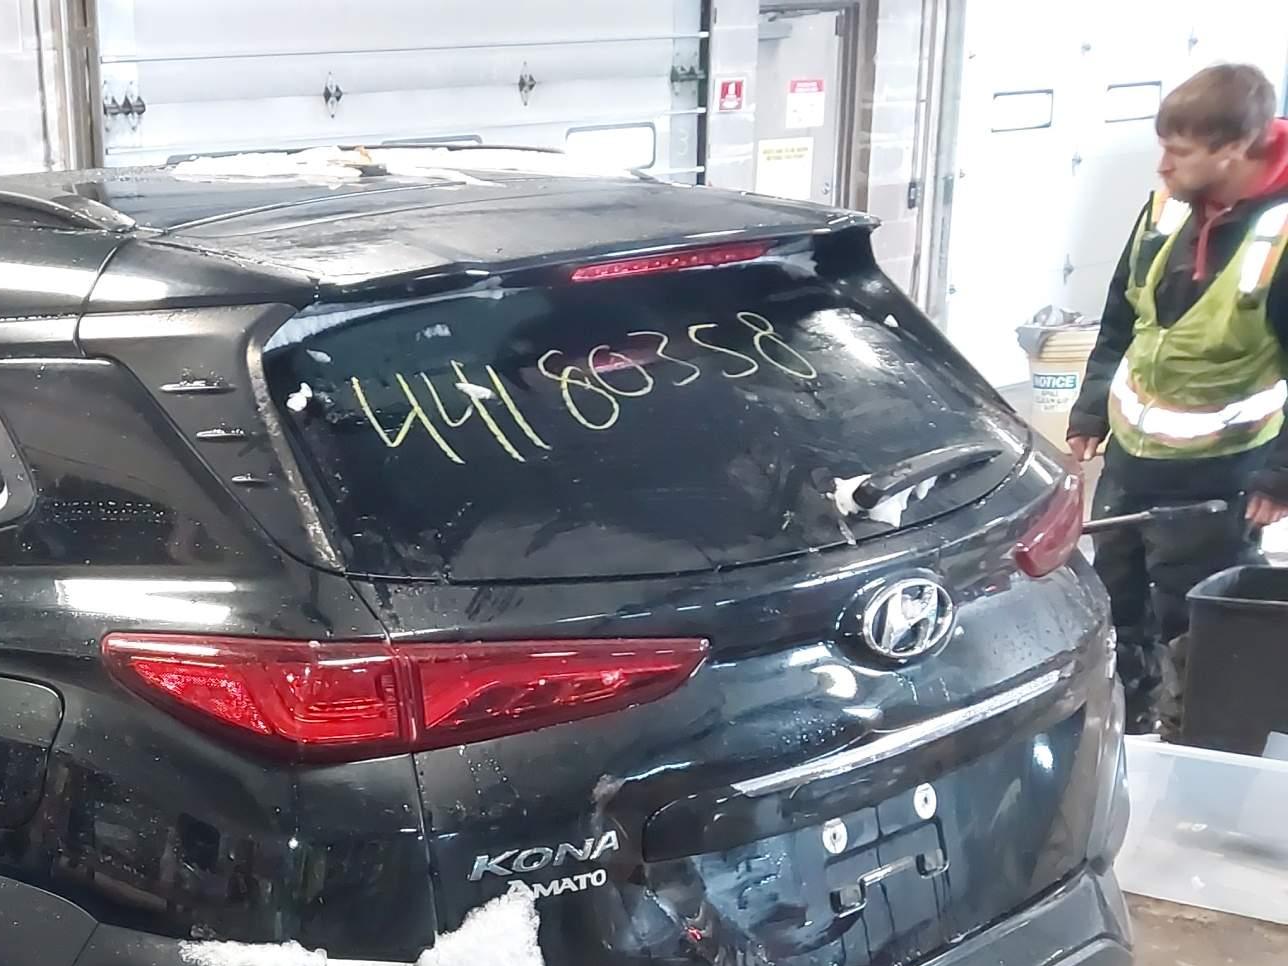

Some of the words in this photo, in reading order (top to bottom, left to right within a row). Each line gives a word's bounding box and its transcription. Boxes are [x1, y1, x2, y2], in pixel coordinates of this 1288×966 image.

[351, 311, 818, 464] 44180358
[1034, 375, 1076, 388] NOTICE
[468, 829, 620, 881] KONA
